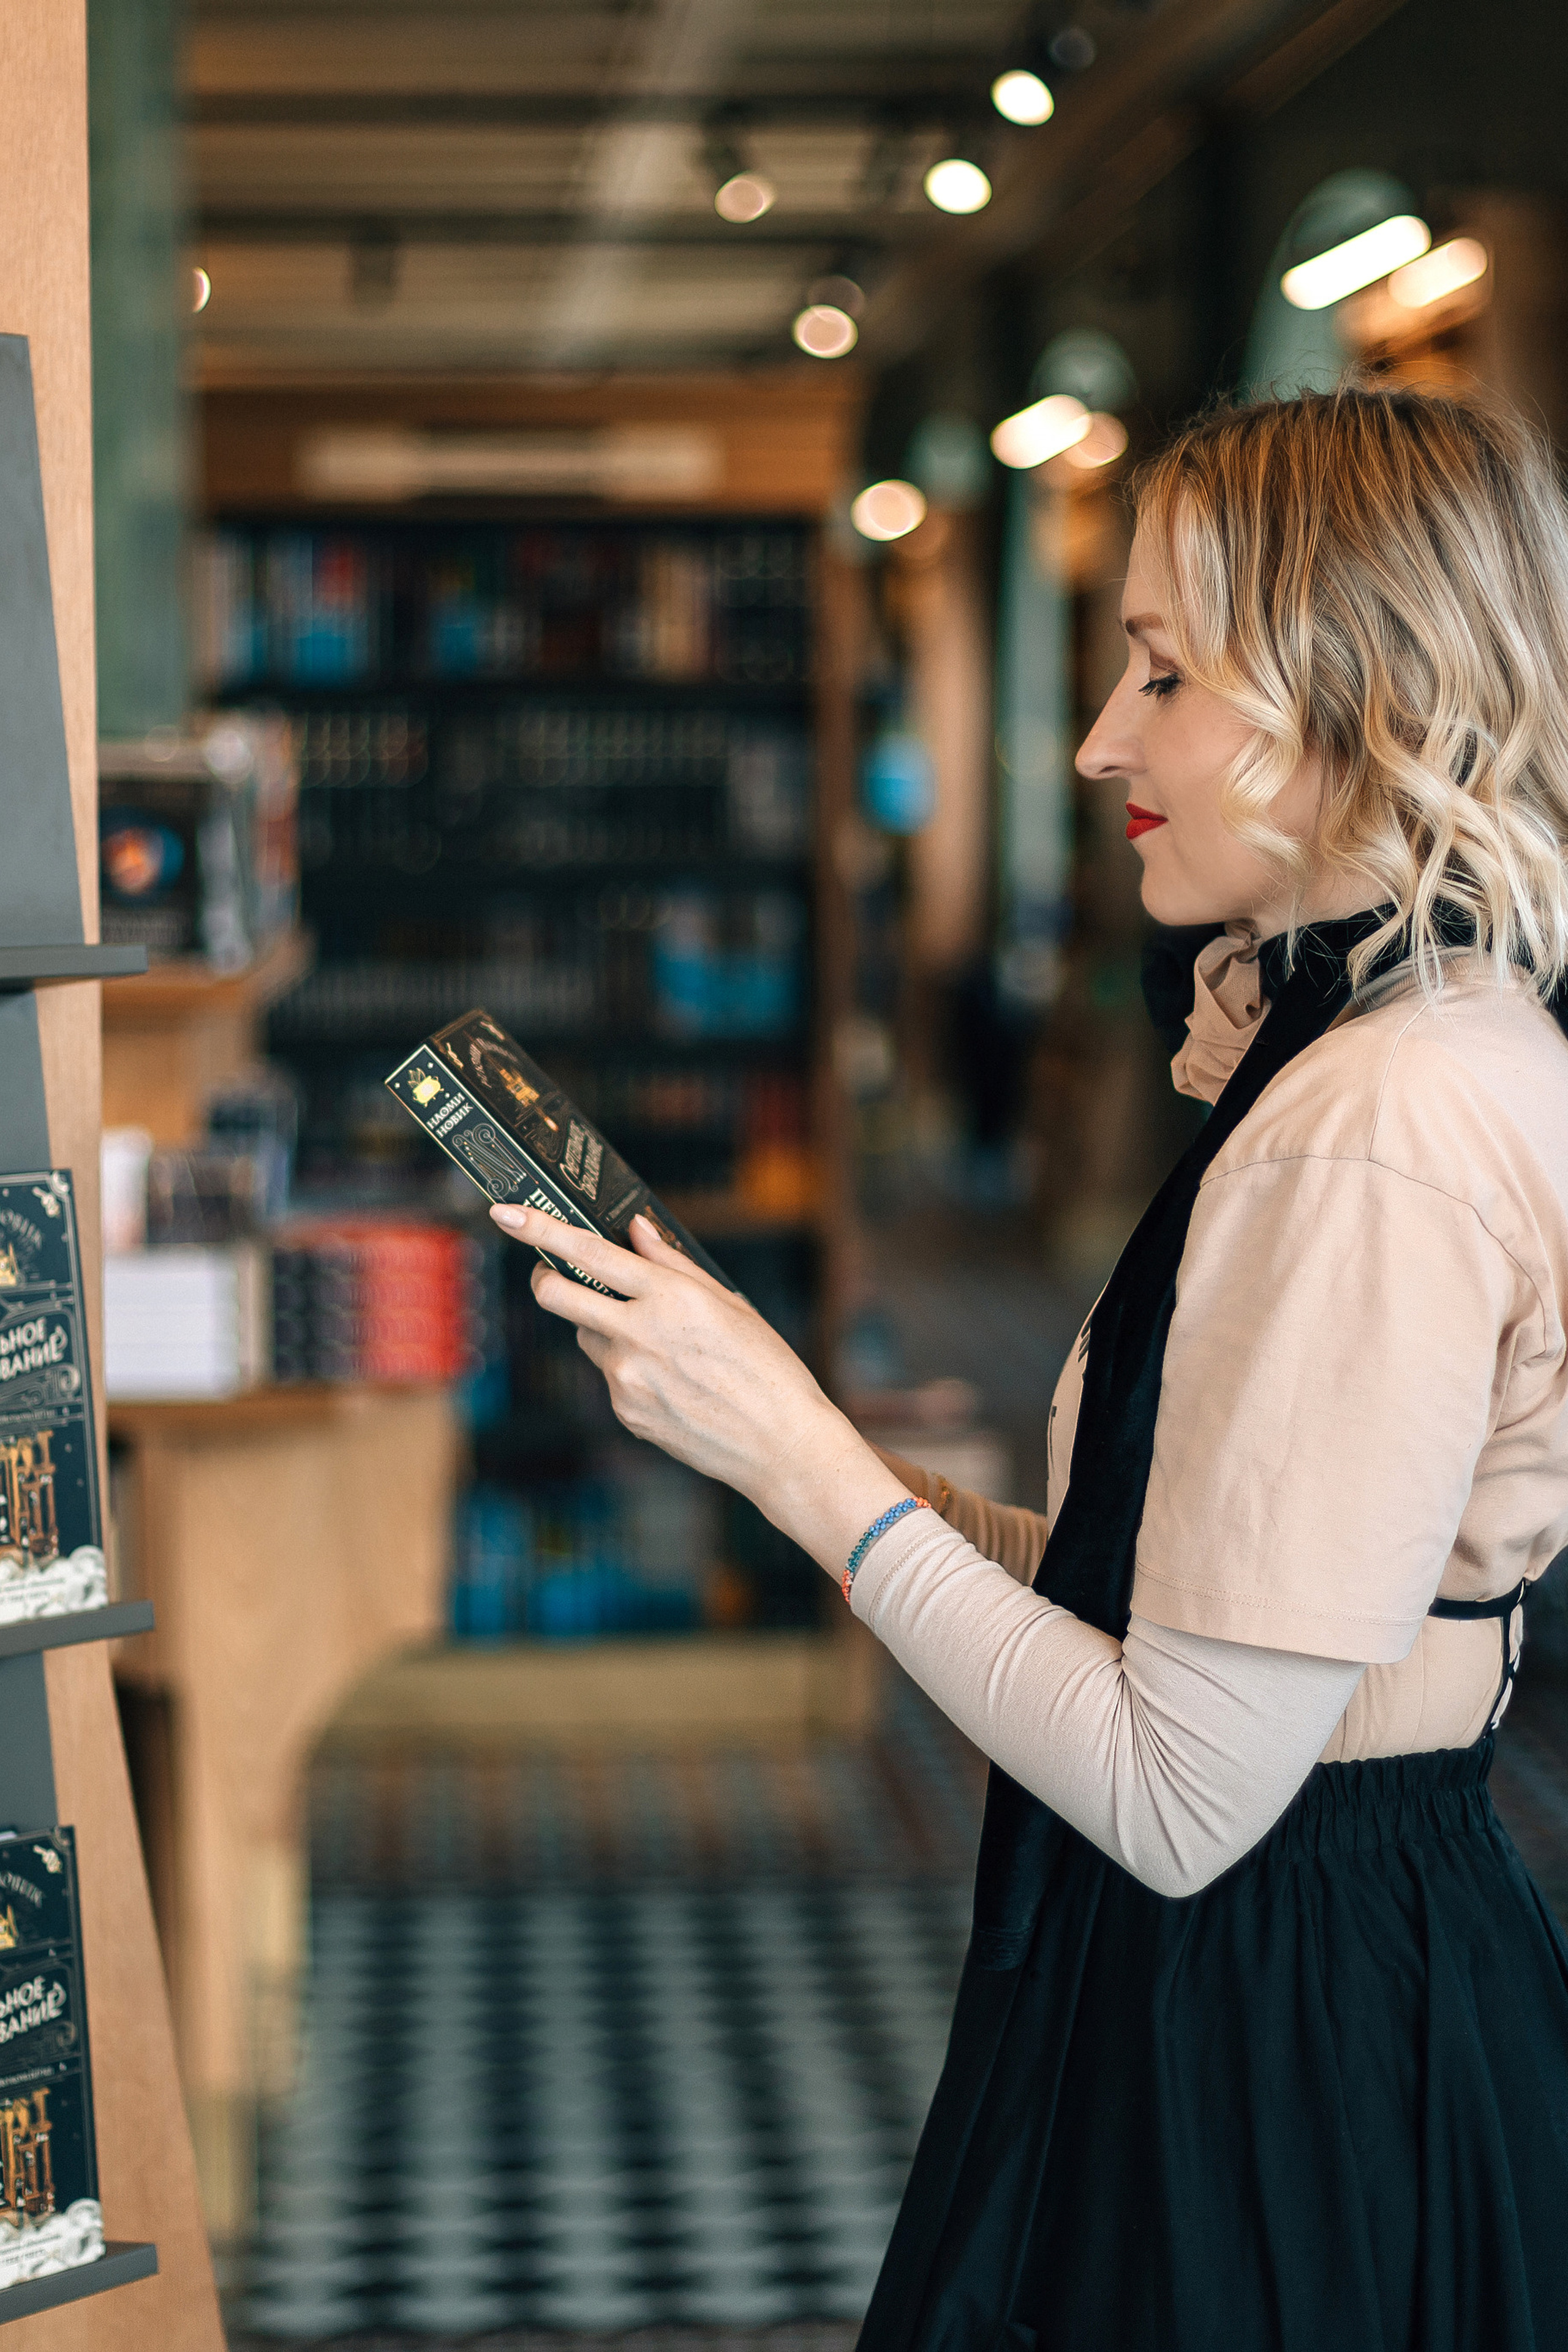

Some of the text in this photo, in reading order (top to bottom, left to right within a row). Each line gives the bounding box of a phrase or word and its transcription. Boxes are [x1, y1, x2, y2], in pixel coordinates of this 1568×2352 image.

[426, 1092, 465, 1129] НАОМИ
[436, 1102, 473, 1136] НОВИК
[529, 1188, 572, 1226] ПЕР
